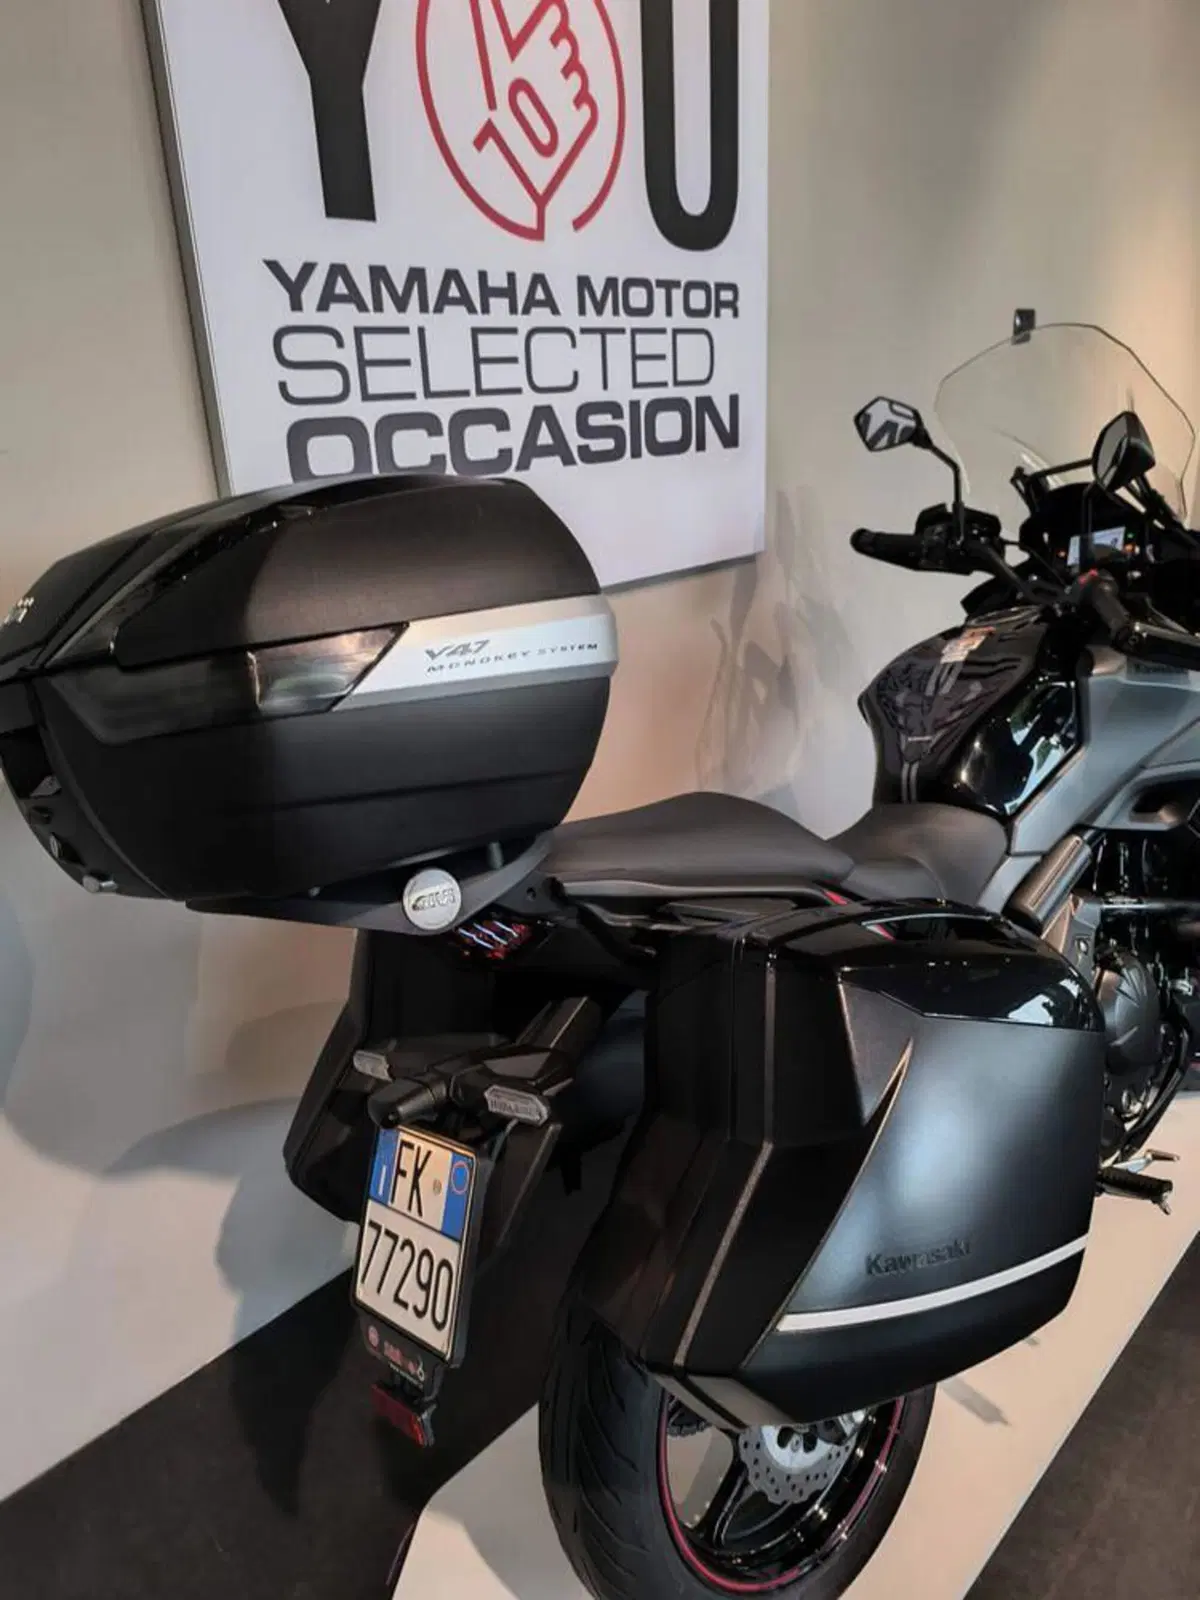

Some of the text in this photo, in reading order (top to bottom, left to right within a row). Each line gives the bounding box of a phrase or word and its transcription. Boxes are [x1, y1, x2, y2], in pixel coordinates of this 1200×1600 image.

[263, 259, 740, 319] YAMAHA MOTOR
[272, 325, 715, 406] SELECTED
[286, 394, 740, 480] OCCASION
[427, 642, 599, 673] MONOKEY SYSTEM
[390, 1139, 432, 1217] FK
[360, 1219, 453, 1332] 77290
[865, 1239, 971, 1275] Kawasaki
